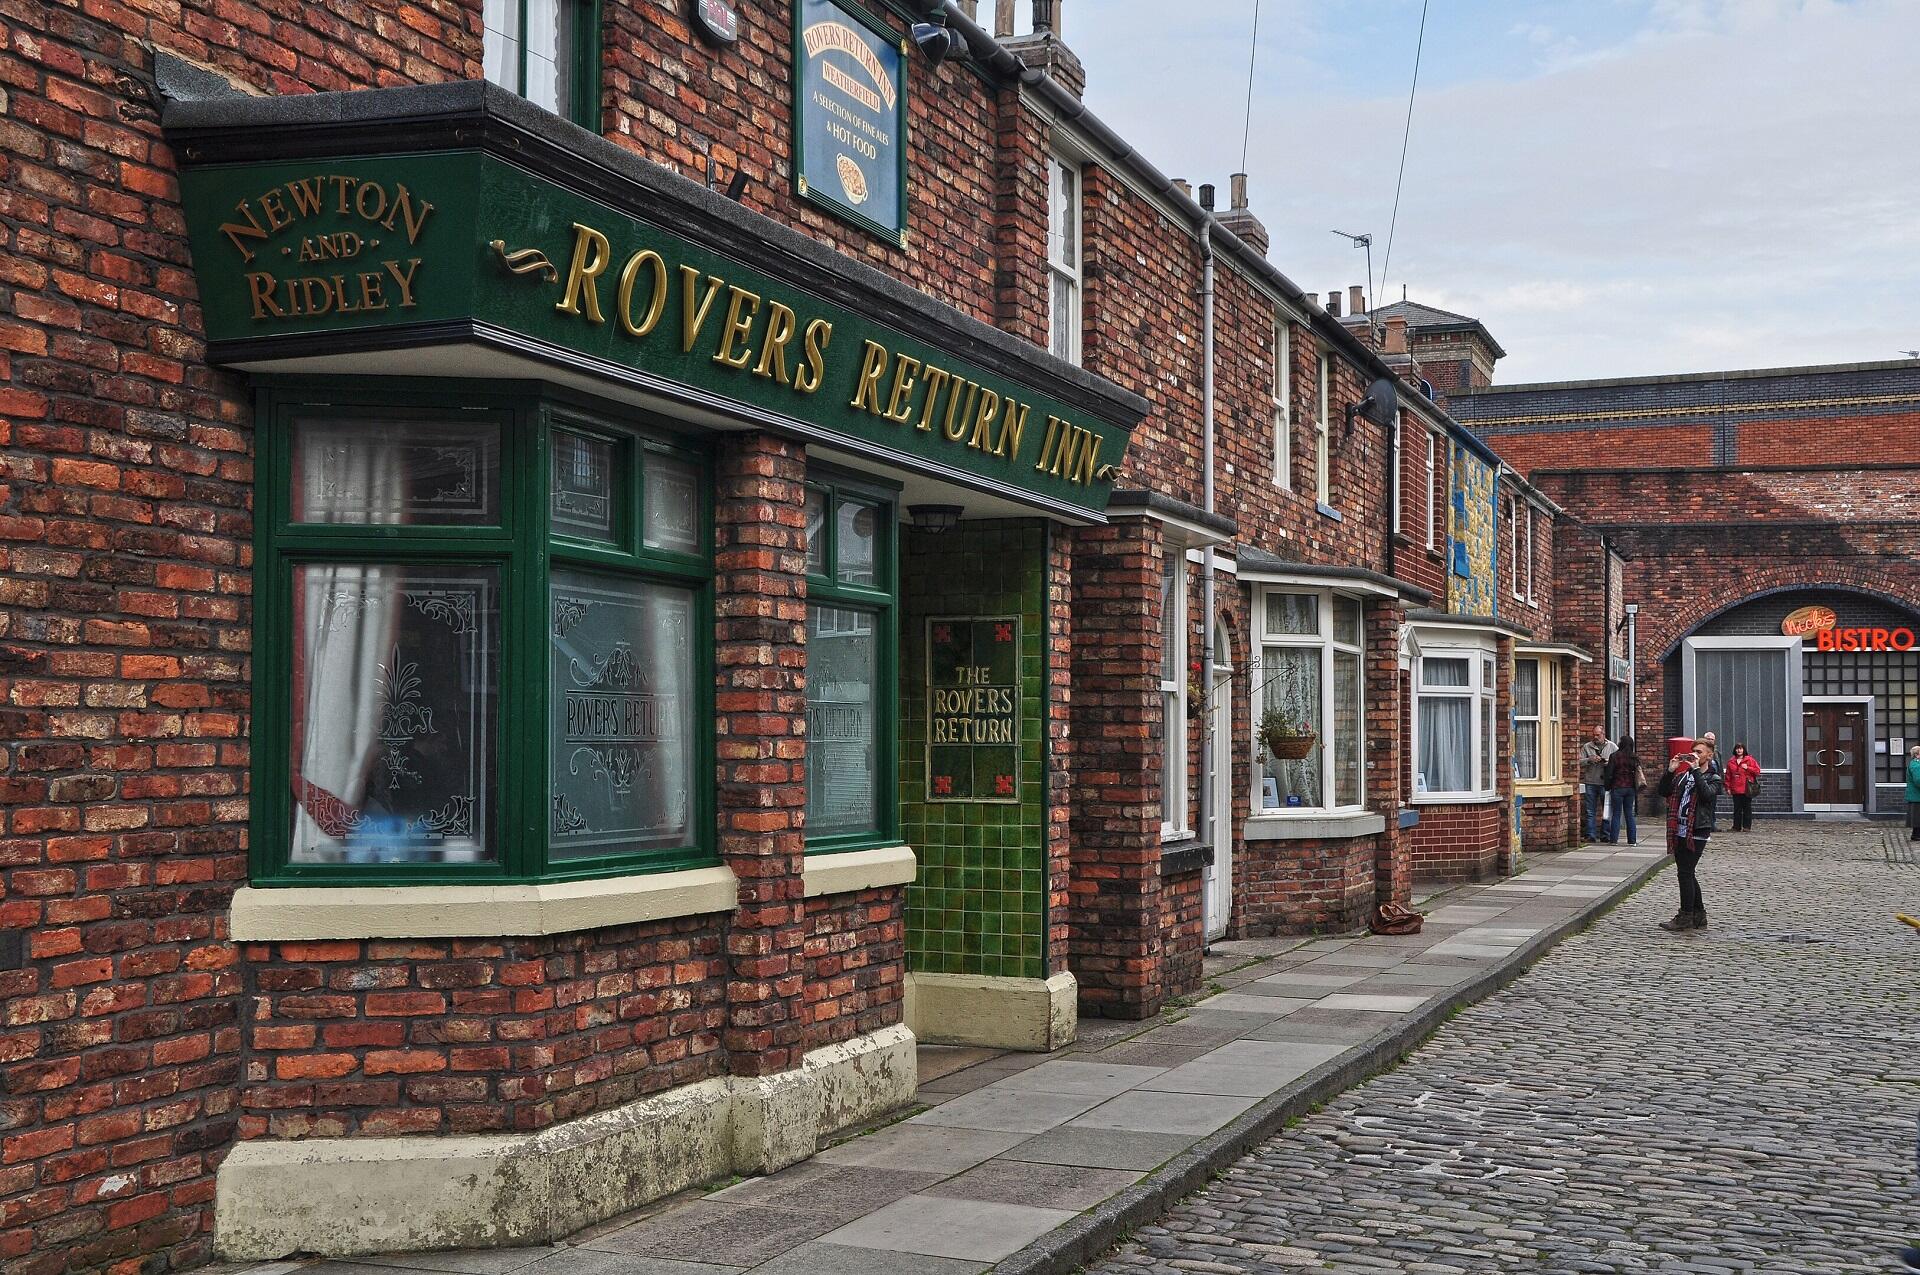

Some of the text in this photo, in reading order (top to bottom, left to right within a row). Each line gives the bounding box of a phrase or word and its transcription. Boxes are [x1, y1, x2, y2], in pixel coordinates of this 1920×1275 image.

[805, 25, 894, 104] ROVERS RETURN INN
[824, 62, 879, 109] WEATHERFIELD
[813, 90, 889, 146] A SELECTION OF FINE ALES
[826, 120, 876, 159] & HOT FOOD
[218, 175, 435, 263] NEWTON
[298, 231, 364, 262] AND
[244, 258, 422, 319] RIDLEY
[556, 222, 1104, 487] ROVERS RETURN INN
[1818, 627, 1916, 651] BISTRO
[955, 665, 990, 685] THE
[566, 697, 619, 736] ROVERS
[935, 688, 1012, 715] ROVERS
[826, 707, 863, 737] RETURN
[935, 718, 1012, 744] RETURN
